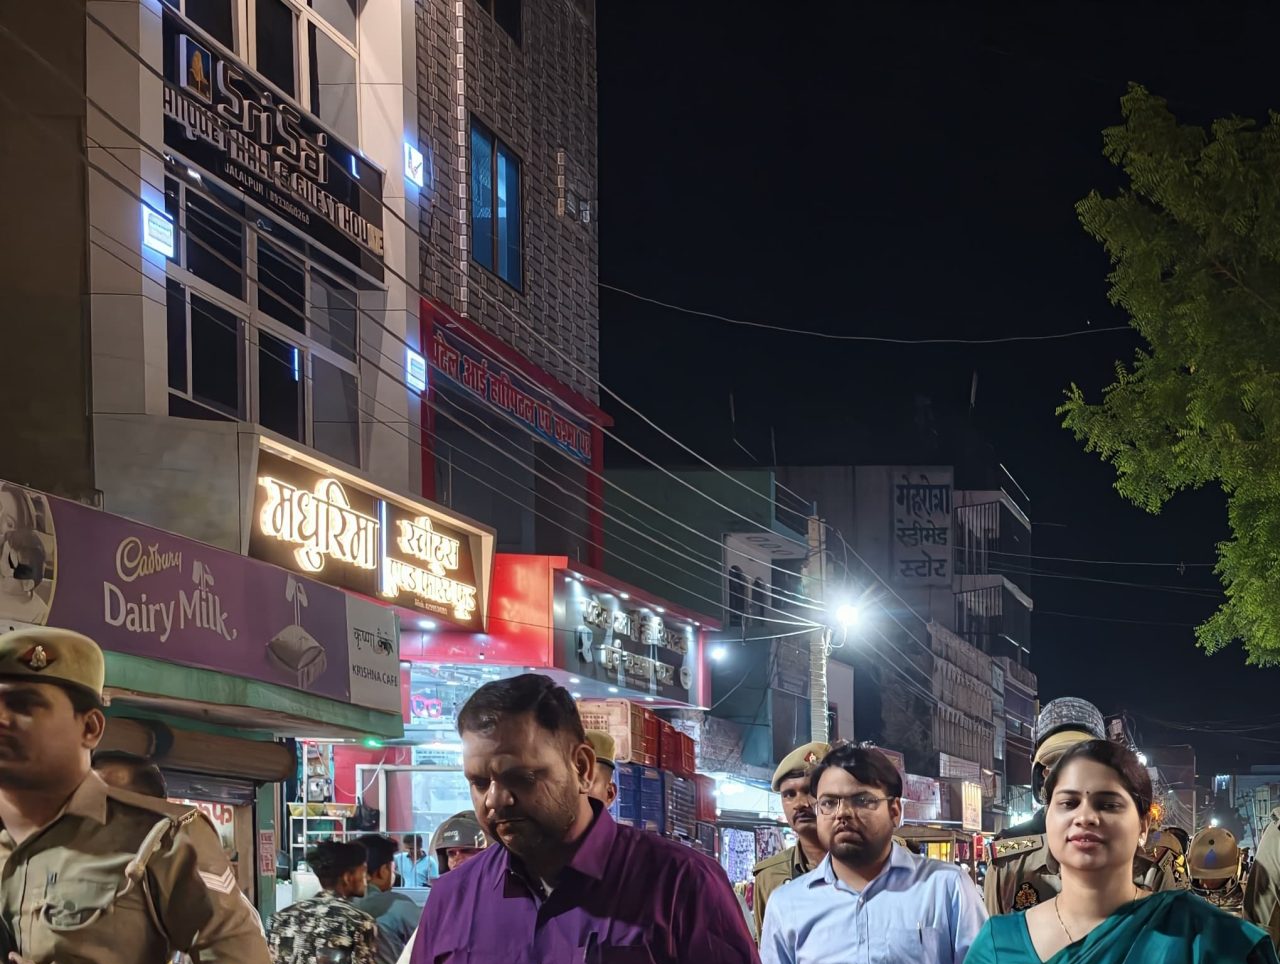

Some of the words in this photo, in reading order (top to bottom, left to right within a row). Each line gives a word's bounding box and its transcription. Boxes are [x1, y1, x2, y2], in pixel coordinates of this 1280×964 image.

[217, 59, 273, 145] Sri
[276, 103, 329, 184] Sai
[224, 162, 265, 196] JALALPUR
[115, 536, 182, 582] Cadbury
[899, 550, 948, 578] स्टोर
[103, 580, 175, 642] Dairy
[179, 588, 232, 641] Milk
[352, 663, 382, 682] KRISHNA
